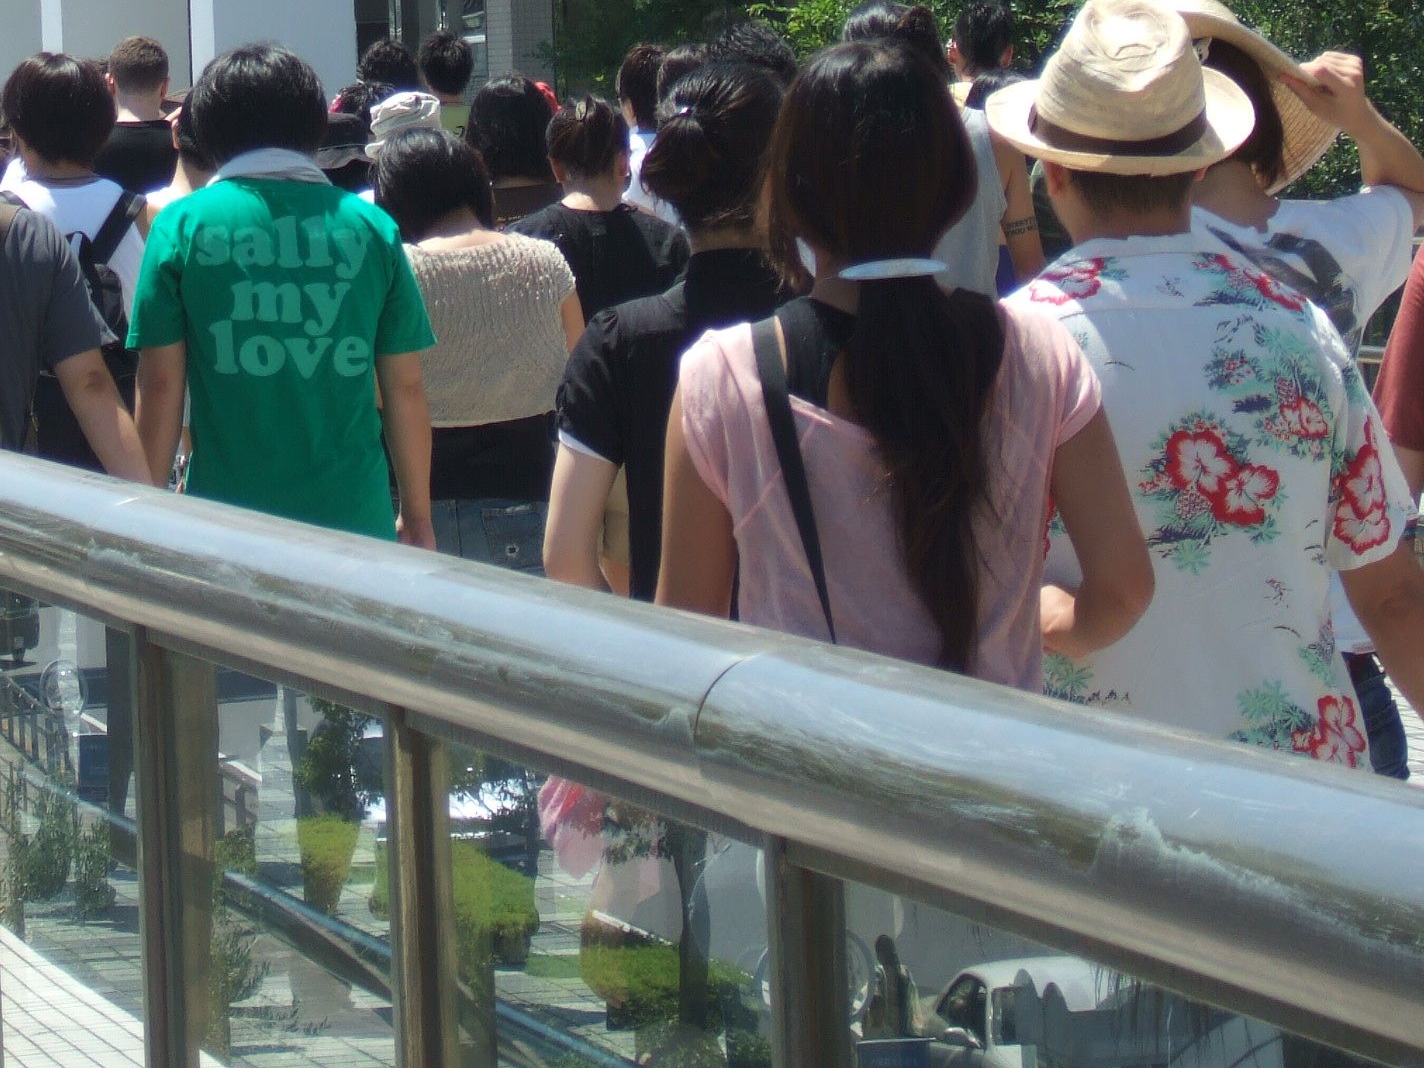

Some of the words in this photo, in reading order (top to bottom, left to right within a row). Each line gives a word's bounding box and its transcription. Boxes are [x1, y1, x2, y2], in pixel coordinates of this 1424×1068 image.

[195, 215, 373, 279] sally
[230, 280, 352, 336] my
[208, 319, 369, 380] love
